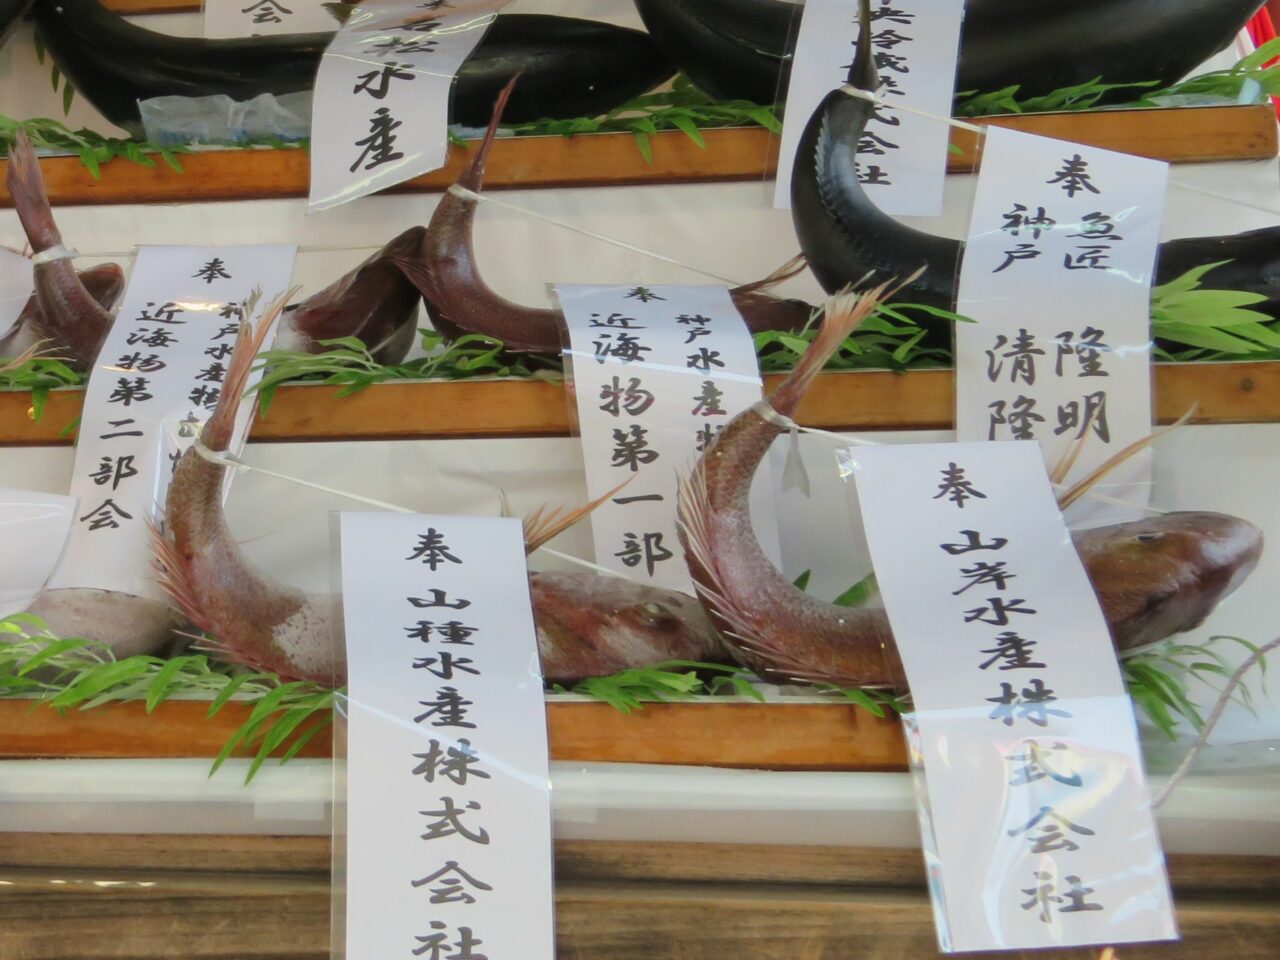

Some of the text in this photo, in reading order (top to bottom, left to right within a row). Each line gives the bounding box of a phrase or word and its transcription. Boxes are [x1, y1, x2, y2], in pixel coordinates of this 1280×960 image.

[1045, 154, 1100, 198] 奉
[192, 258, 232, 284] 奉
[623, 286, 667, 303] 奉
[80, 302, 188, 531] 近海物第二部会
[589, 313, 673, 578] 近海物第一部
